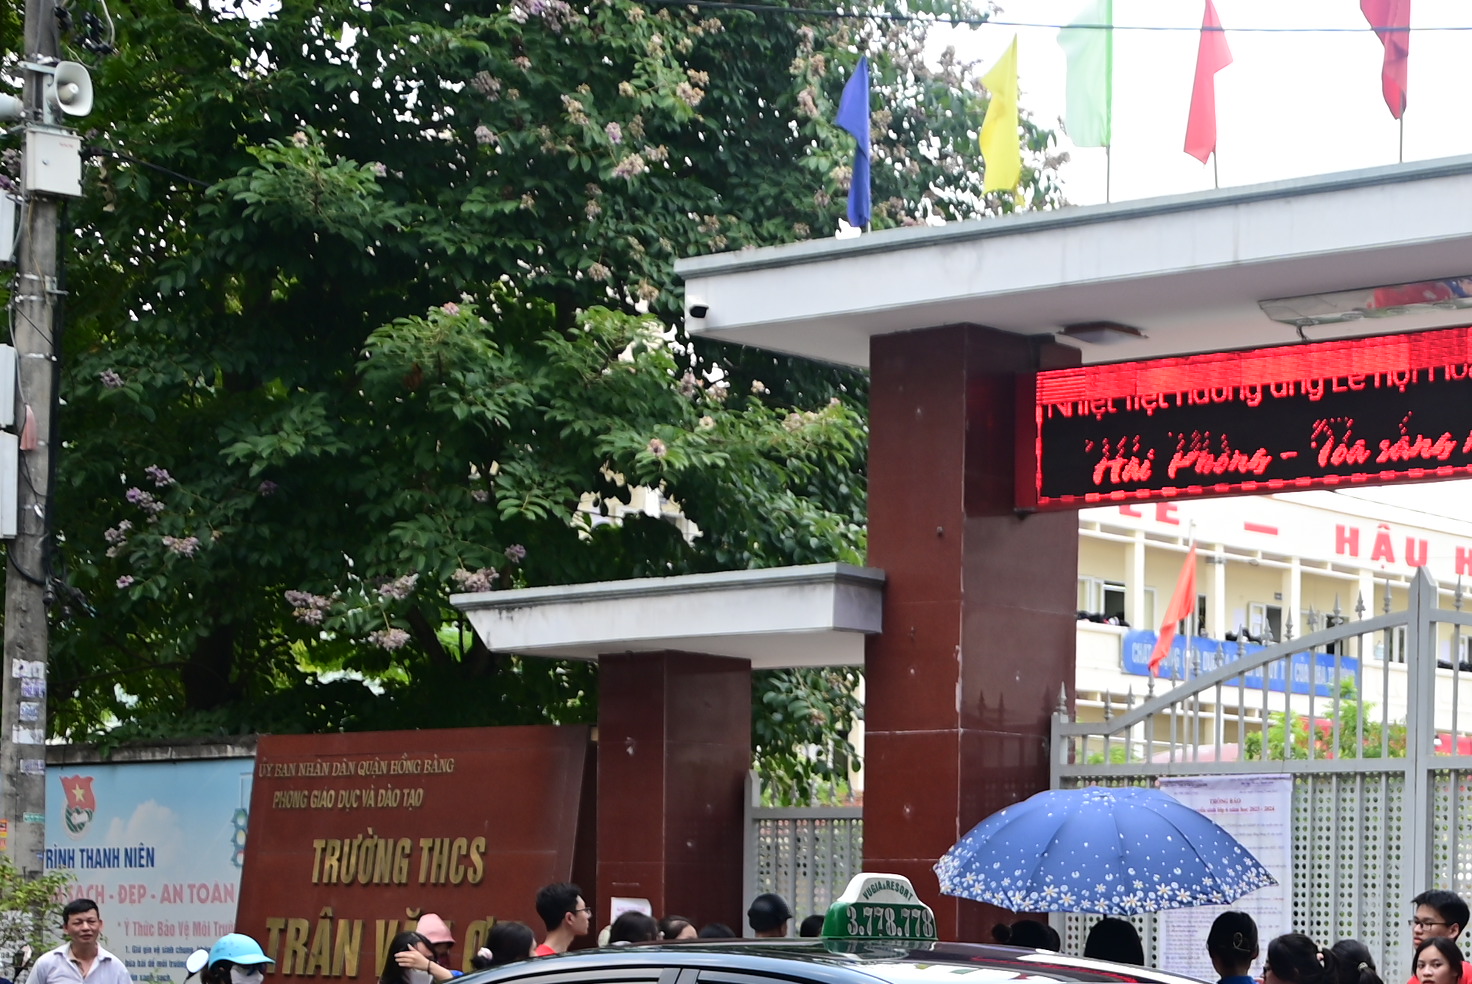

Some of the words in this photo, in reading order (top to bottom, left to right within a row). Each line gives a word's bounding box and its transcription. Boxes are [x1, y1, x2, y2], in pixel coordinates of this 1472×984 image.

[1334, 523, 1429, 570] HẬU
[259, 757, 274, 777] ỦY
[274, 762, 297, 777] BAN
[298, 759, 331, 777] NHÂN
[332, 758, 356, 776] DÂN
[357, 757, 388, 778] QUẬN
[390, 753, 422, 774] HỒNG
[423, 754, 455, 773] BÀNG
[310, 785, 336, 808] GIÁO
[337, 788, 360, 812] DỤC
[362, 785, 375, 807] VÀ
[402, 788, 424, 811] TẠO
[79, 847, 120, 869] THANH
[124, 843, 155, 868] NIÊN
[311, 827, 413, 884] TRƯỜNG
[418, 836, 486, 885] THCS
[118, 884, 147, 906] ĐẸP
[160, 884, 184, 904] AN
[187, 881, 235, 904] TOÀN
[846, 906, 934, 938] 3.778.778
